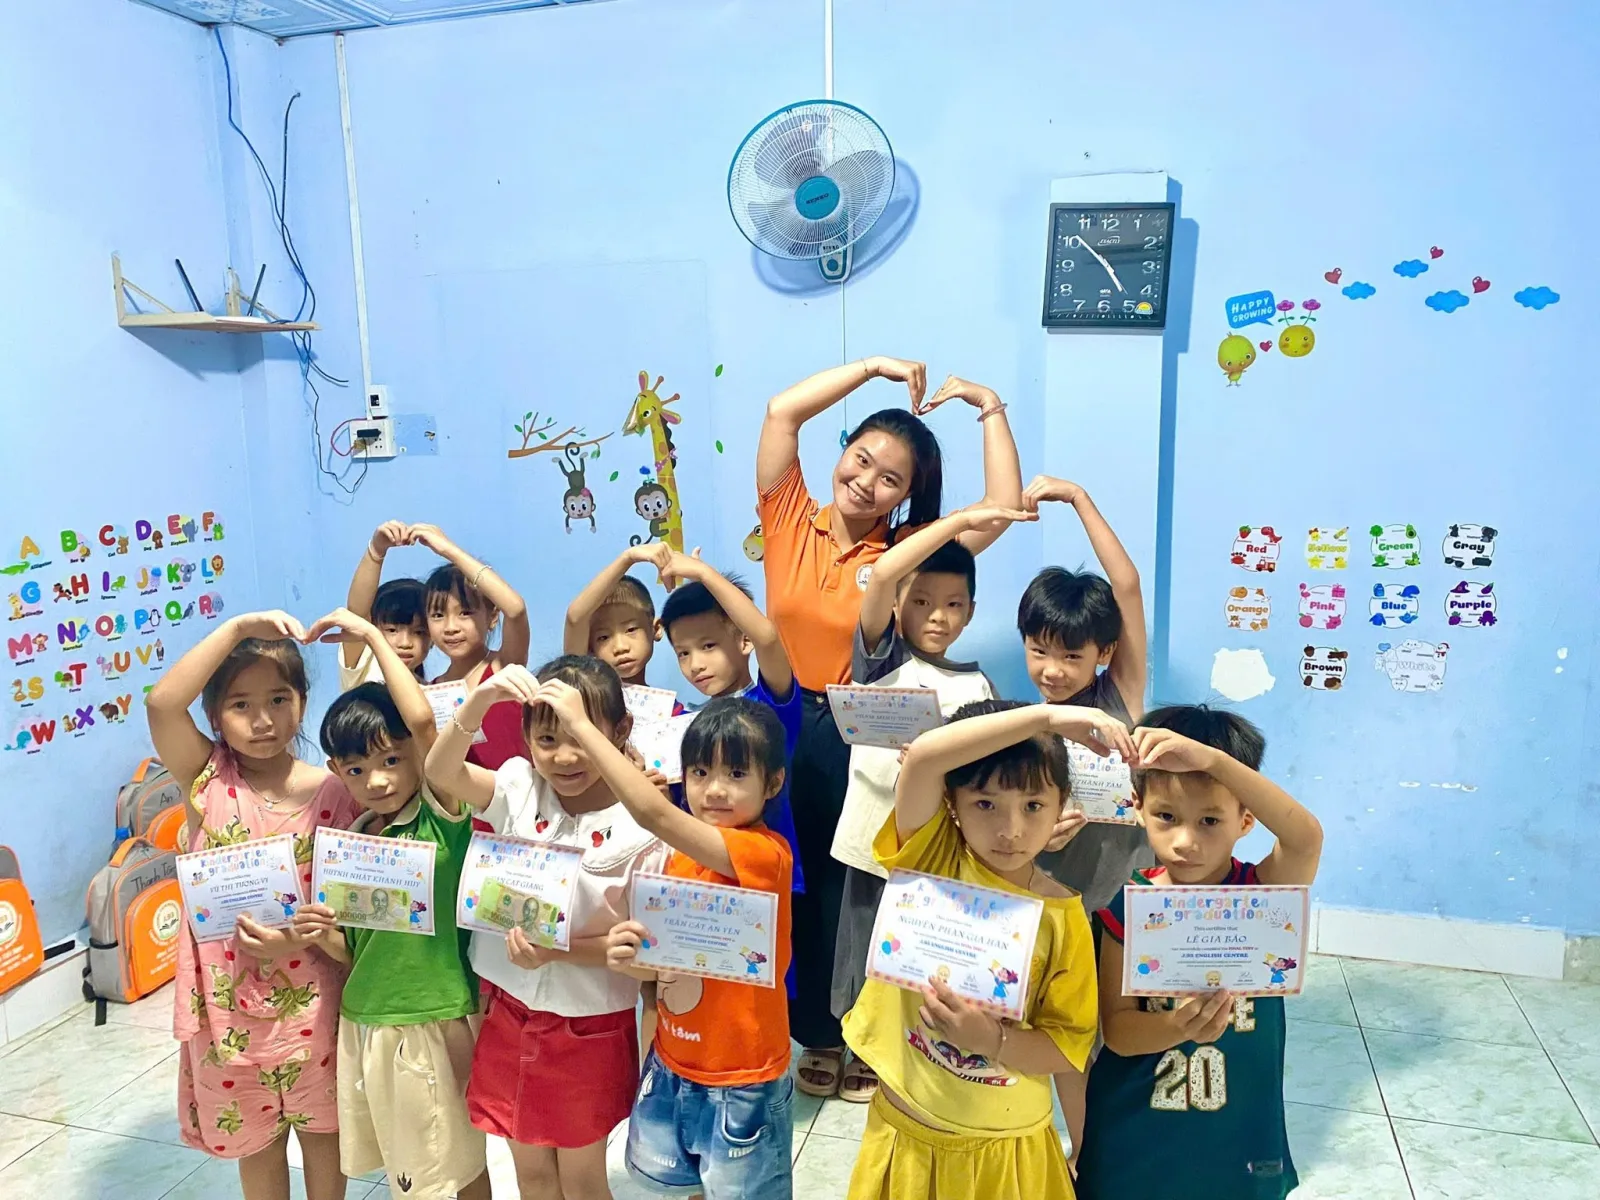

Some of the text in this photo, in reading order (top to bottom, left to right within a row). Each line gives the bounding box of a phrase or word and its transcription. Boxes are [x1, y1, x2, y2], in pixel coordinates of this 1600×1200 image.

[1078, 218, 1091, 231] 11
[1101, 218, 1120, 232] 12
[1134, 219, 1141, 231] 1
[1062, 235, 1081, 248] 10
[1144, 236, 1157, 249] 2
[1061, 260, 1074, 272] 9
[1142, 260, 1155, 273] 3
[1060, 283, 1072, 296] 8
[1140, 284, 1153, 297] 4
[1073, 300, 1086, 312] 7
[1097, 300, 1110, 312] 6
[1123, 300, 1136, 312] 5
[1232, 297, 1269, 314] HAPPY
[1233, 306, 1273, 322] GROWING
[136, 520, 152, 541] D
[167, 514, 182, 535] E
[202, 512, 214, 532] F
[60, 530, 78, 552] B
[99, 525, 116, 546] C
[20, 536, 40, 559] A
[1246, 544, 1267, 553] Red
[1308, 543, 1347, 553] Yellow
[1379, 543, 1414, 551] Green
[1453, 541, 1485, 554] Gray
[167, 563, 180, 583] K
[202, 558, 214, 577] L
[71, 573, 89, 596] H
[103, 571, 109, 592] I
[136, 568, 149, 589] J
[21, 581, 41, 604] G
[165, 601, 182, 621] Q
[198, 595, 212, 615] R
[1227, 604, 1268, 615] Orange
[1310, 601, 1336, 611] Pink
[1381, 601, 1407, 610] Blue
[1450, 600, 1492, 610] Purple
[95, 615, 114, 637] O
[134, 609, 149, 630] P
[57, 621, 76, 645] N
[8, 633, 33, 660] M
[135, 644, 152, 665] V
[114, 651, 131, 673] U
[1304, 662, 1343, 672] Brown
[1399, 661, 1436, 672] White
[69, 663, 88, 685] T
[28, 676, 44, 700] S
[116, 694, 132, 715] Y
[75, 705, 95, 729] X
[31, 720, 56, 745] W
[1163, 895, 1269, 909] kindergarten
[1174, 907, 1264, 921] graduation
[1201, 935, 1221, 944] GIA
[1151, 1045, 1227, 1111] 20
